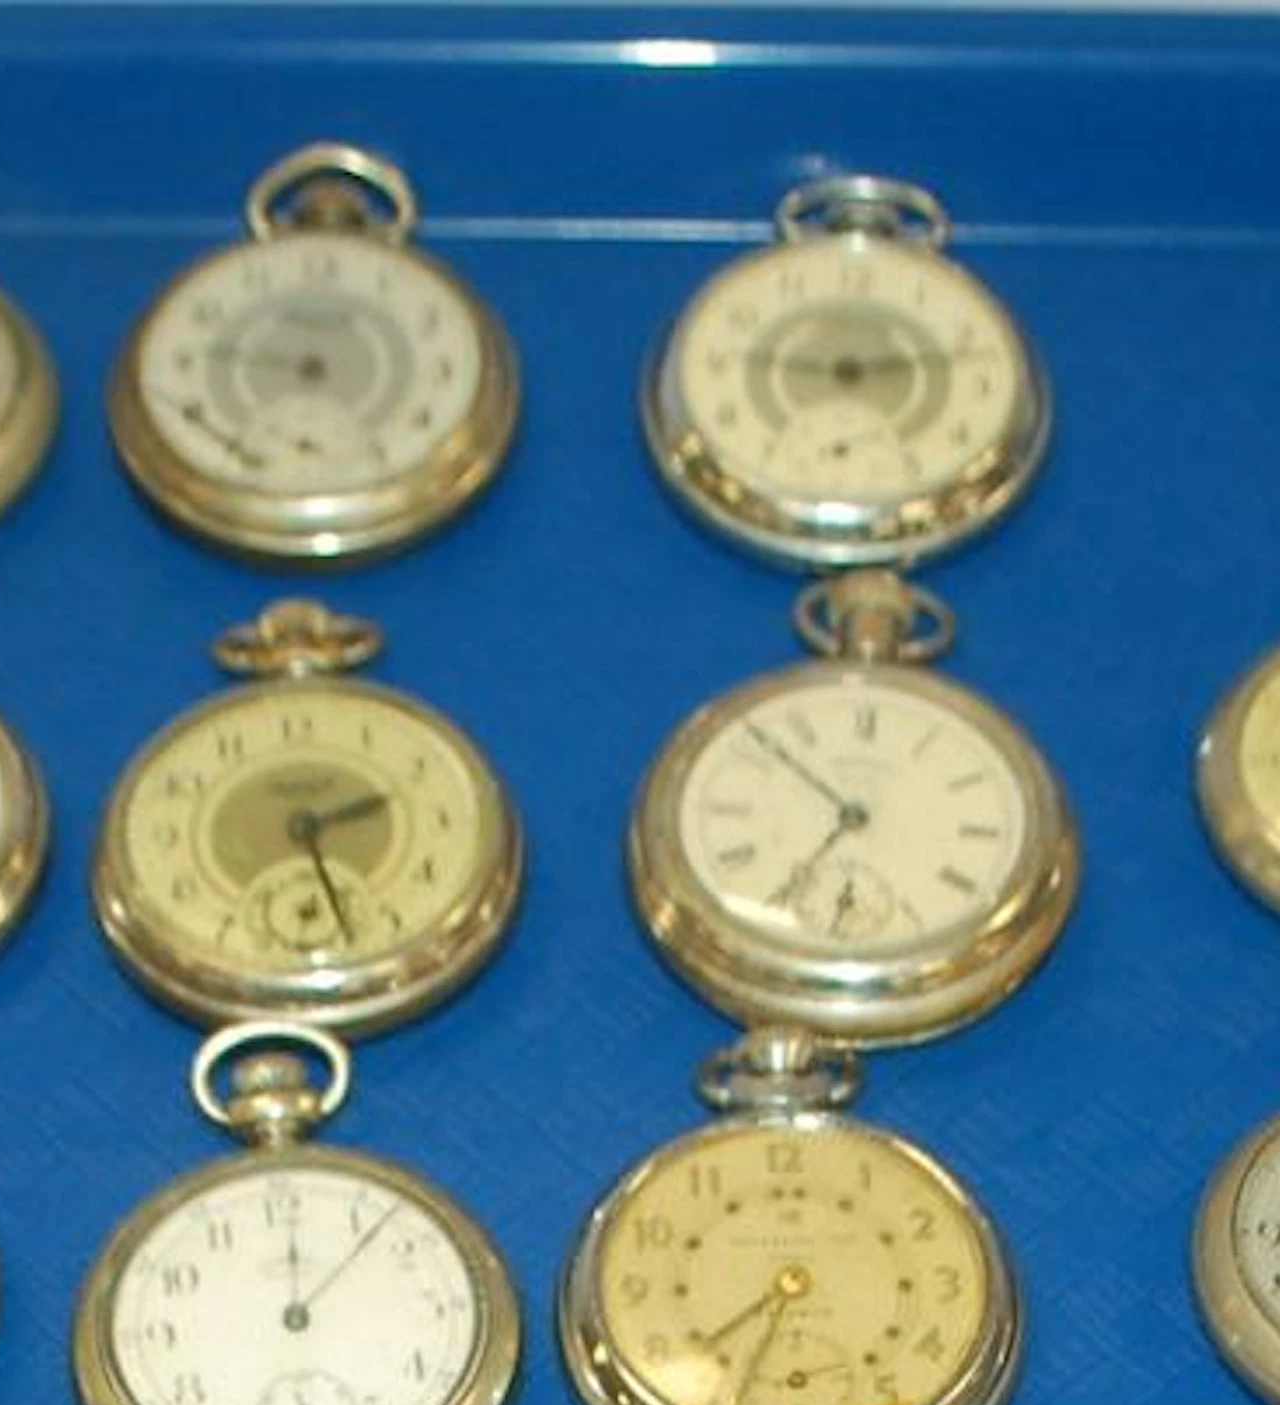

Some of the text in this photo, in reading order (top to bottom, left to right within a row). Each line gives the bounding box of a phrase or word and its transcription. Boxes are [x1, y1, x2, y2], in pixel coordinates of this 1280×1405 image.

[766, 1144, 801, 1174] 12
[690, 1167, 720, 1198] 11
[208, 1220, 232, 1251] 11
[634, 1220, 673, 1252] 10
[909, 1210, 935, 1242] 2
[163, 1266, 199, 1295] 10
[620, 1274, 649, 1308] 9
[933, 1266, 960, 1300] 3
